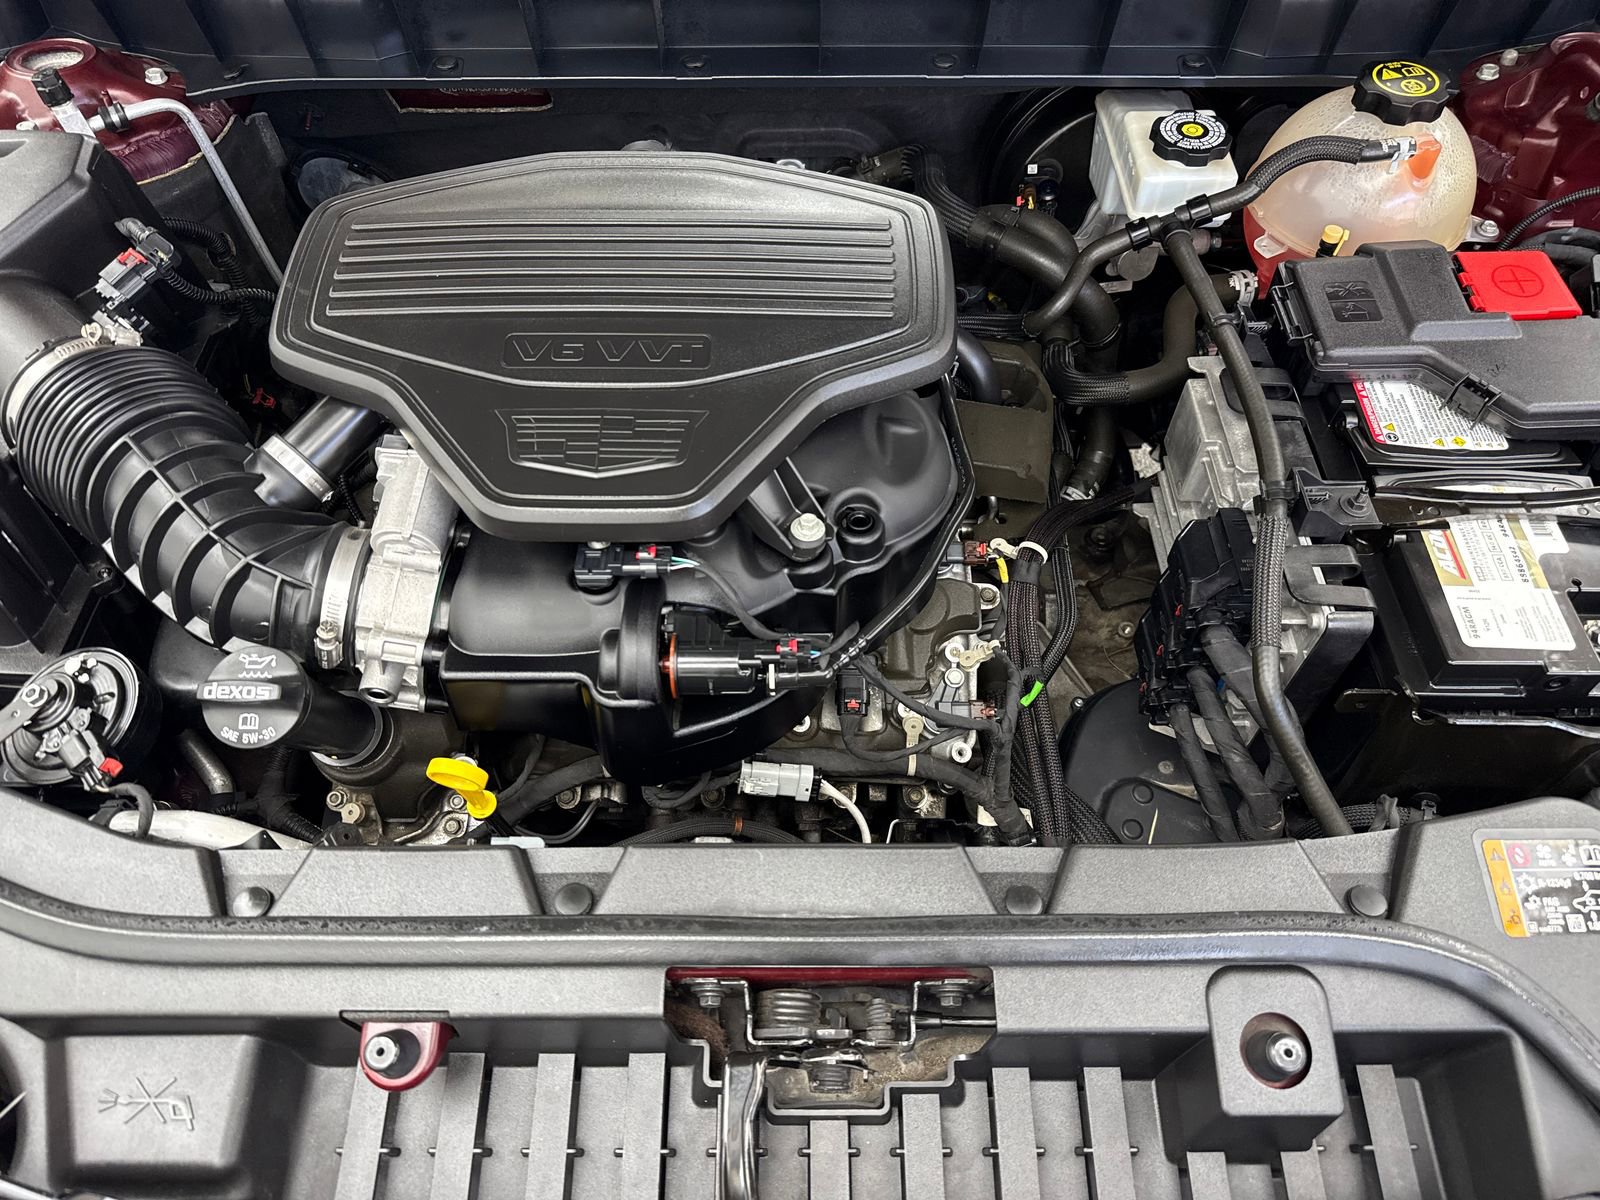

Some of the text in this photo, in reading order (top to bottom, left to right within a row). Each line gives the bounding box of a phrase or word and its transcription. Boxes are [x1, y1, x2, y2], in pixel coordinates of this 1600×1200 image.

[512, 339, 704, 362] V6 VVT
[203, 682, 273, 699] dexos
[220, 726, 276, 744] SAE 5W-30
